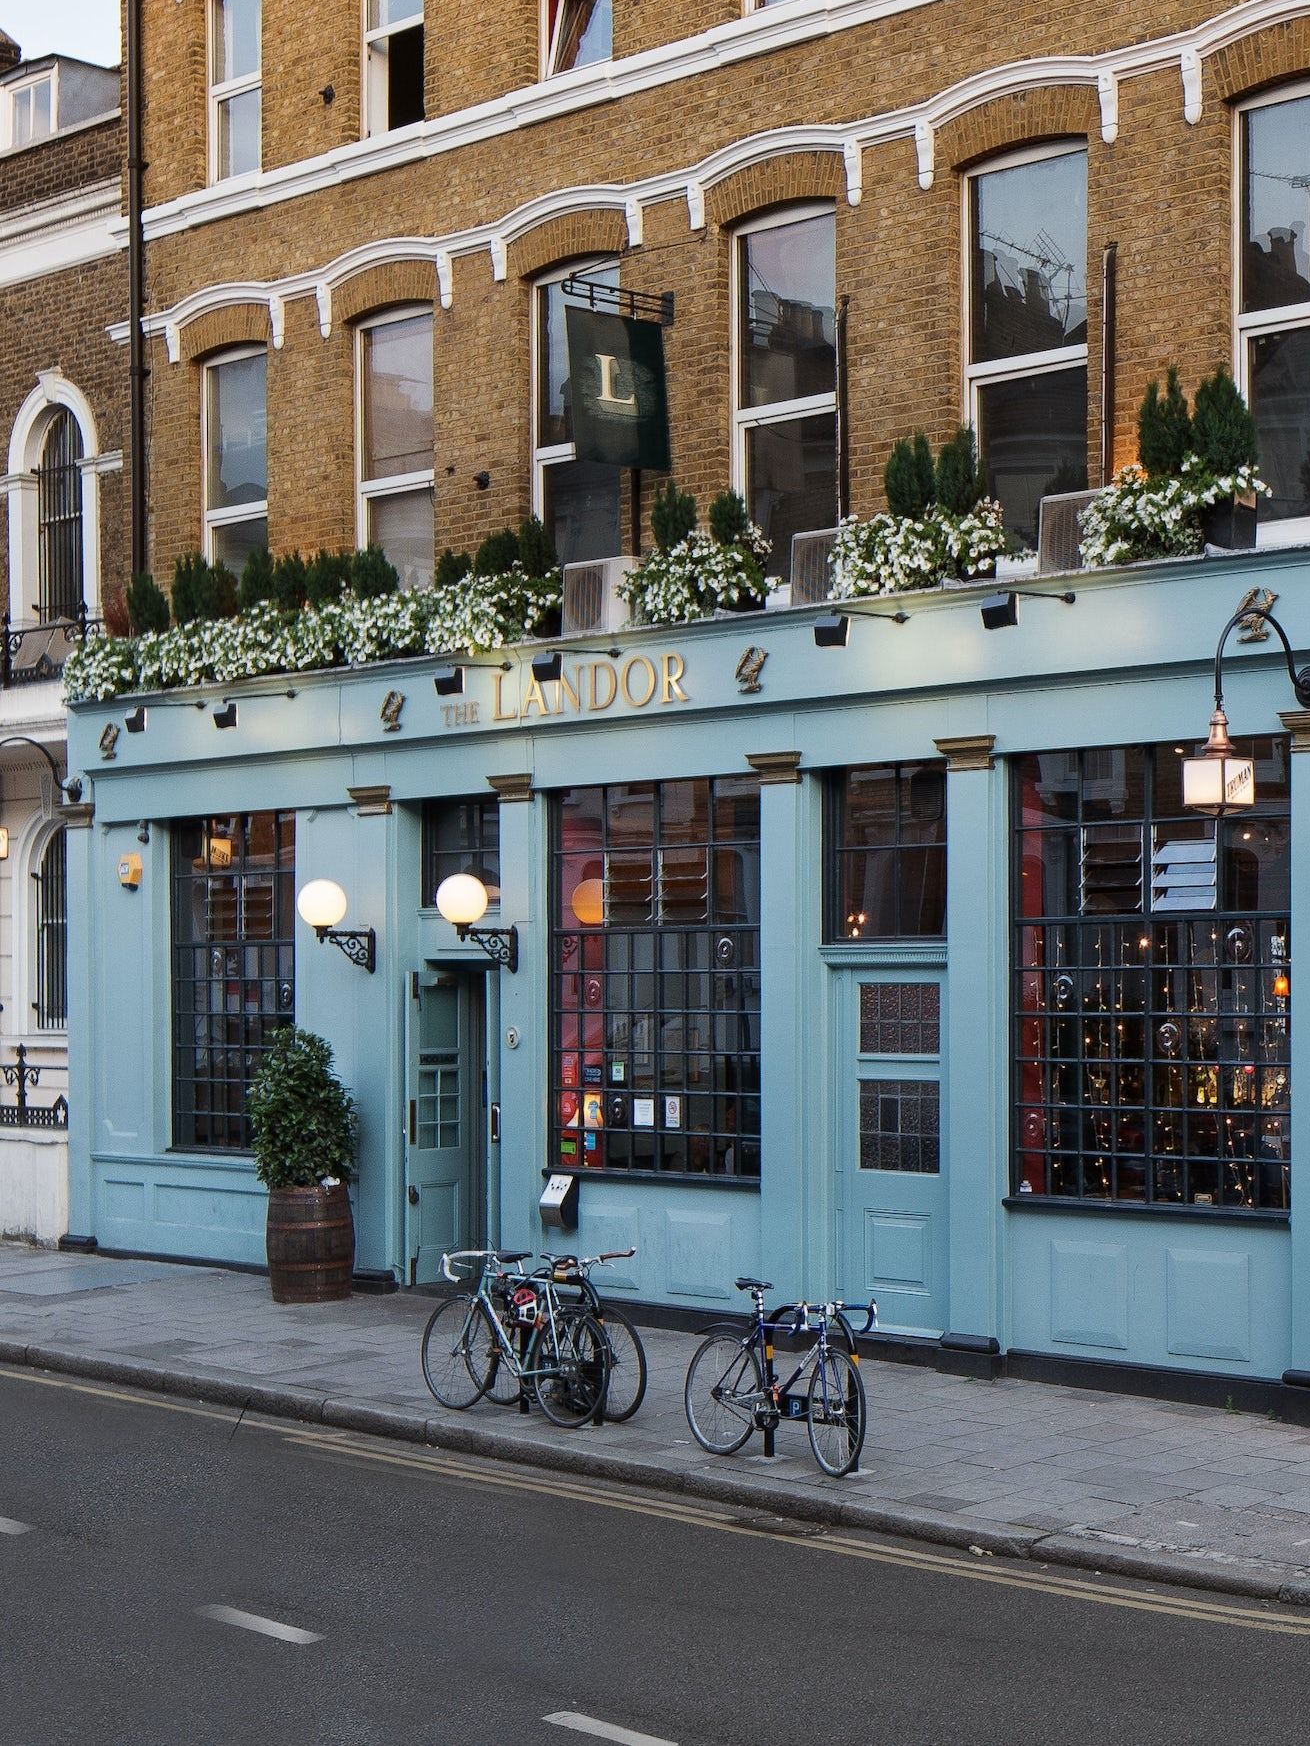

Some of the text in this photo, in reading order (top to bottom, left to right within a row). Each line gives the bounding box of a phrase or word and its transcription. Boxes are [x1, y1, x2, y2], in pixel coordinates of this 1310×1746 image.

[595, 353, 637, 409] L
[441, 653, 690, 727] THE LANDOR
[792, 1401, 800, 1414] P
